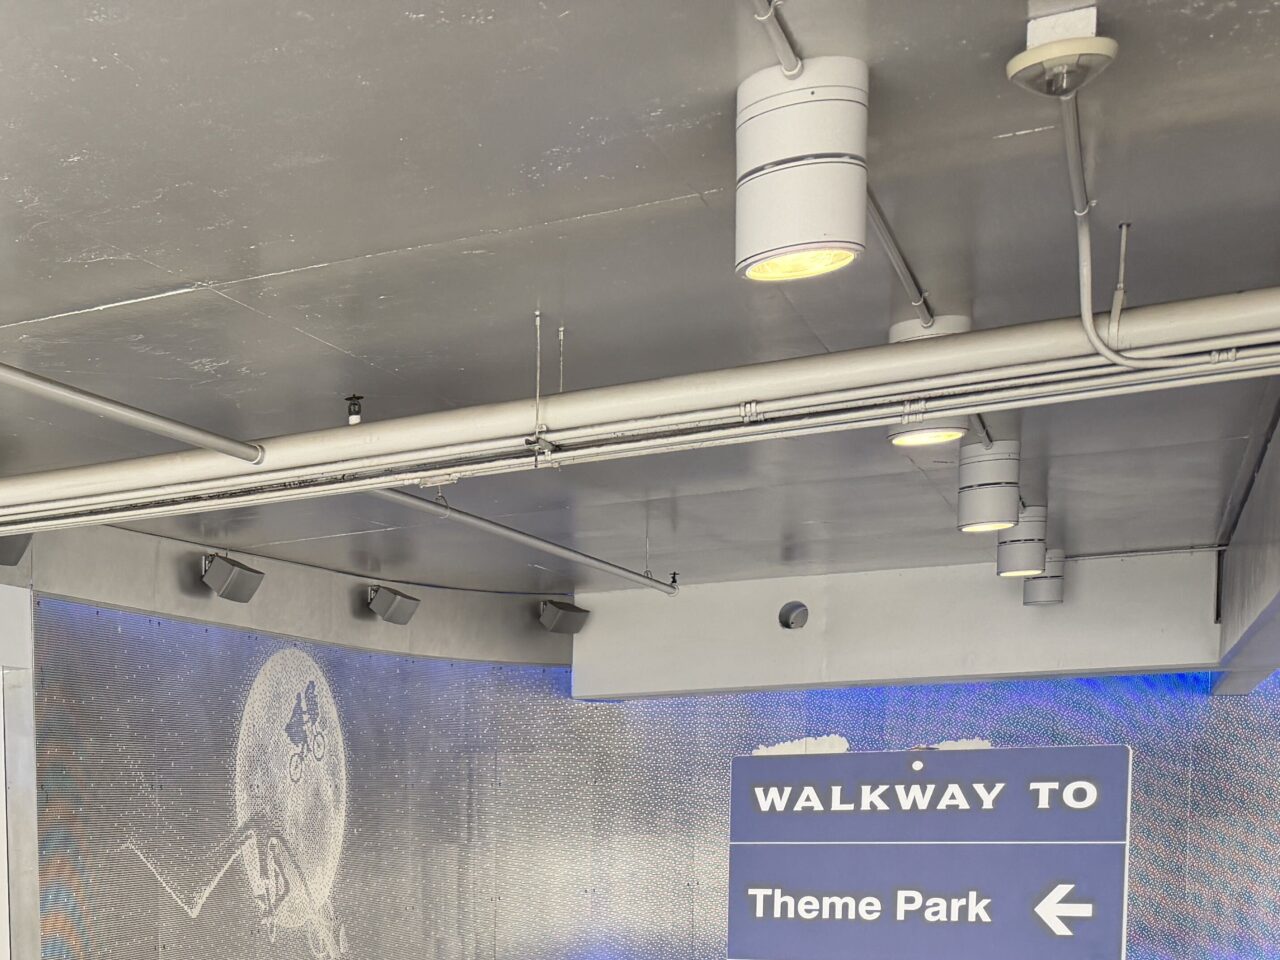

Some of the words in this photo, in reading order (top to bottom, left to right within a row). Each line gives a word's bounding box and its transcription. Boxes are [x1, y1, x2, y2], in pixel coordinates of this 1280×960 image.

[754, 782, 1006, 812] WALKWAY
[1029, 780, 1098, 809] TO
[747, 888, 882, 921] Theme
[896, 890, 992, 923] Park
